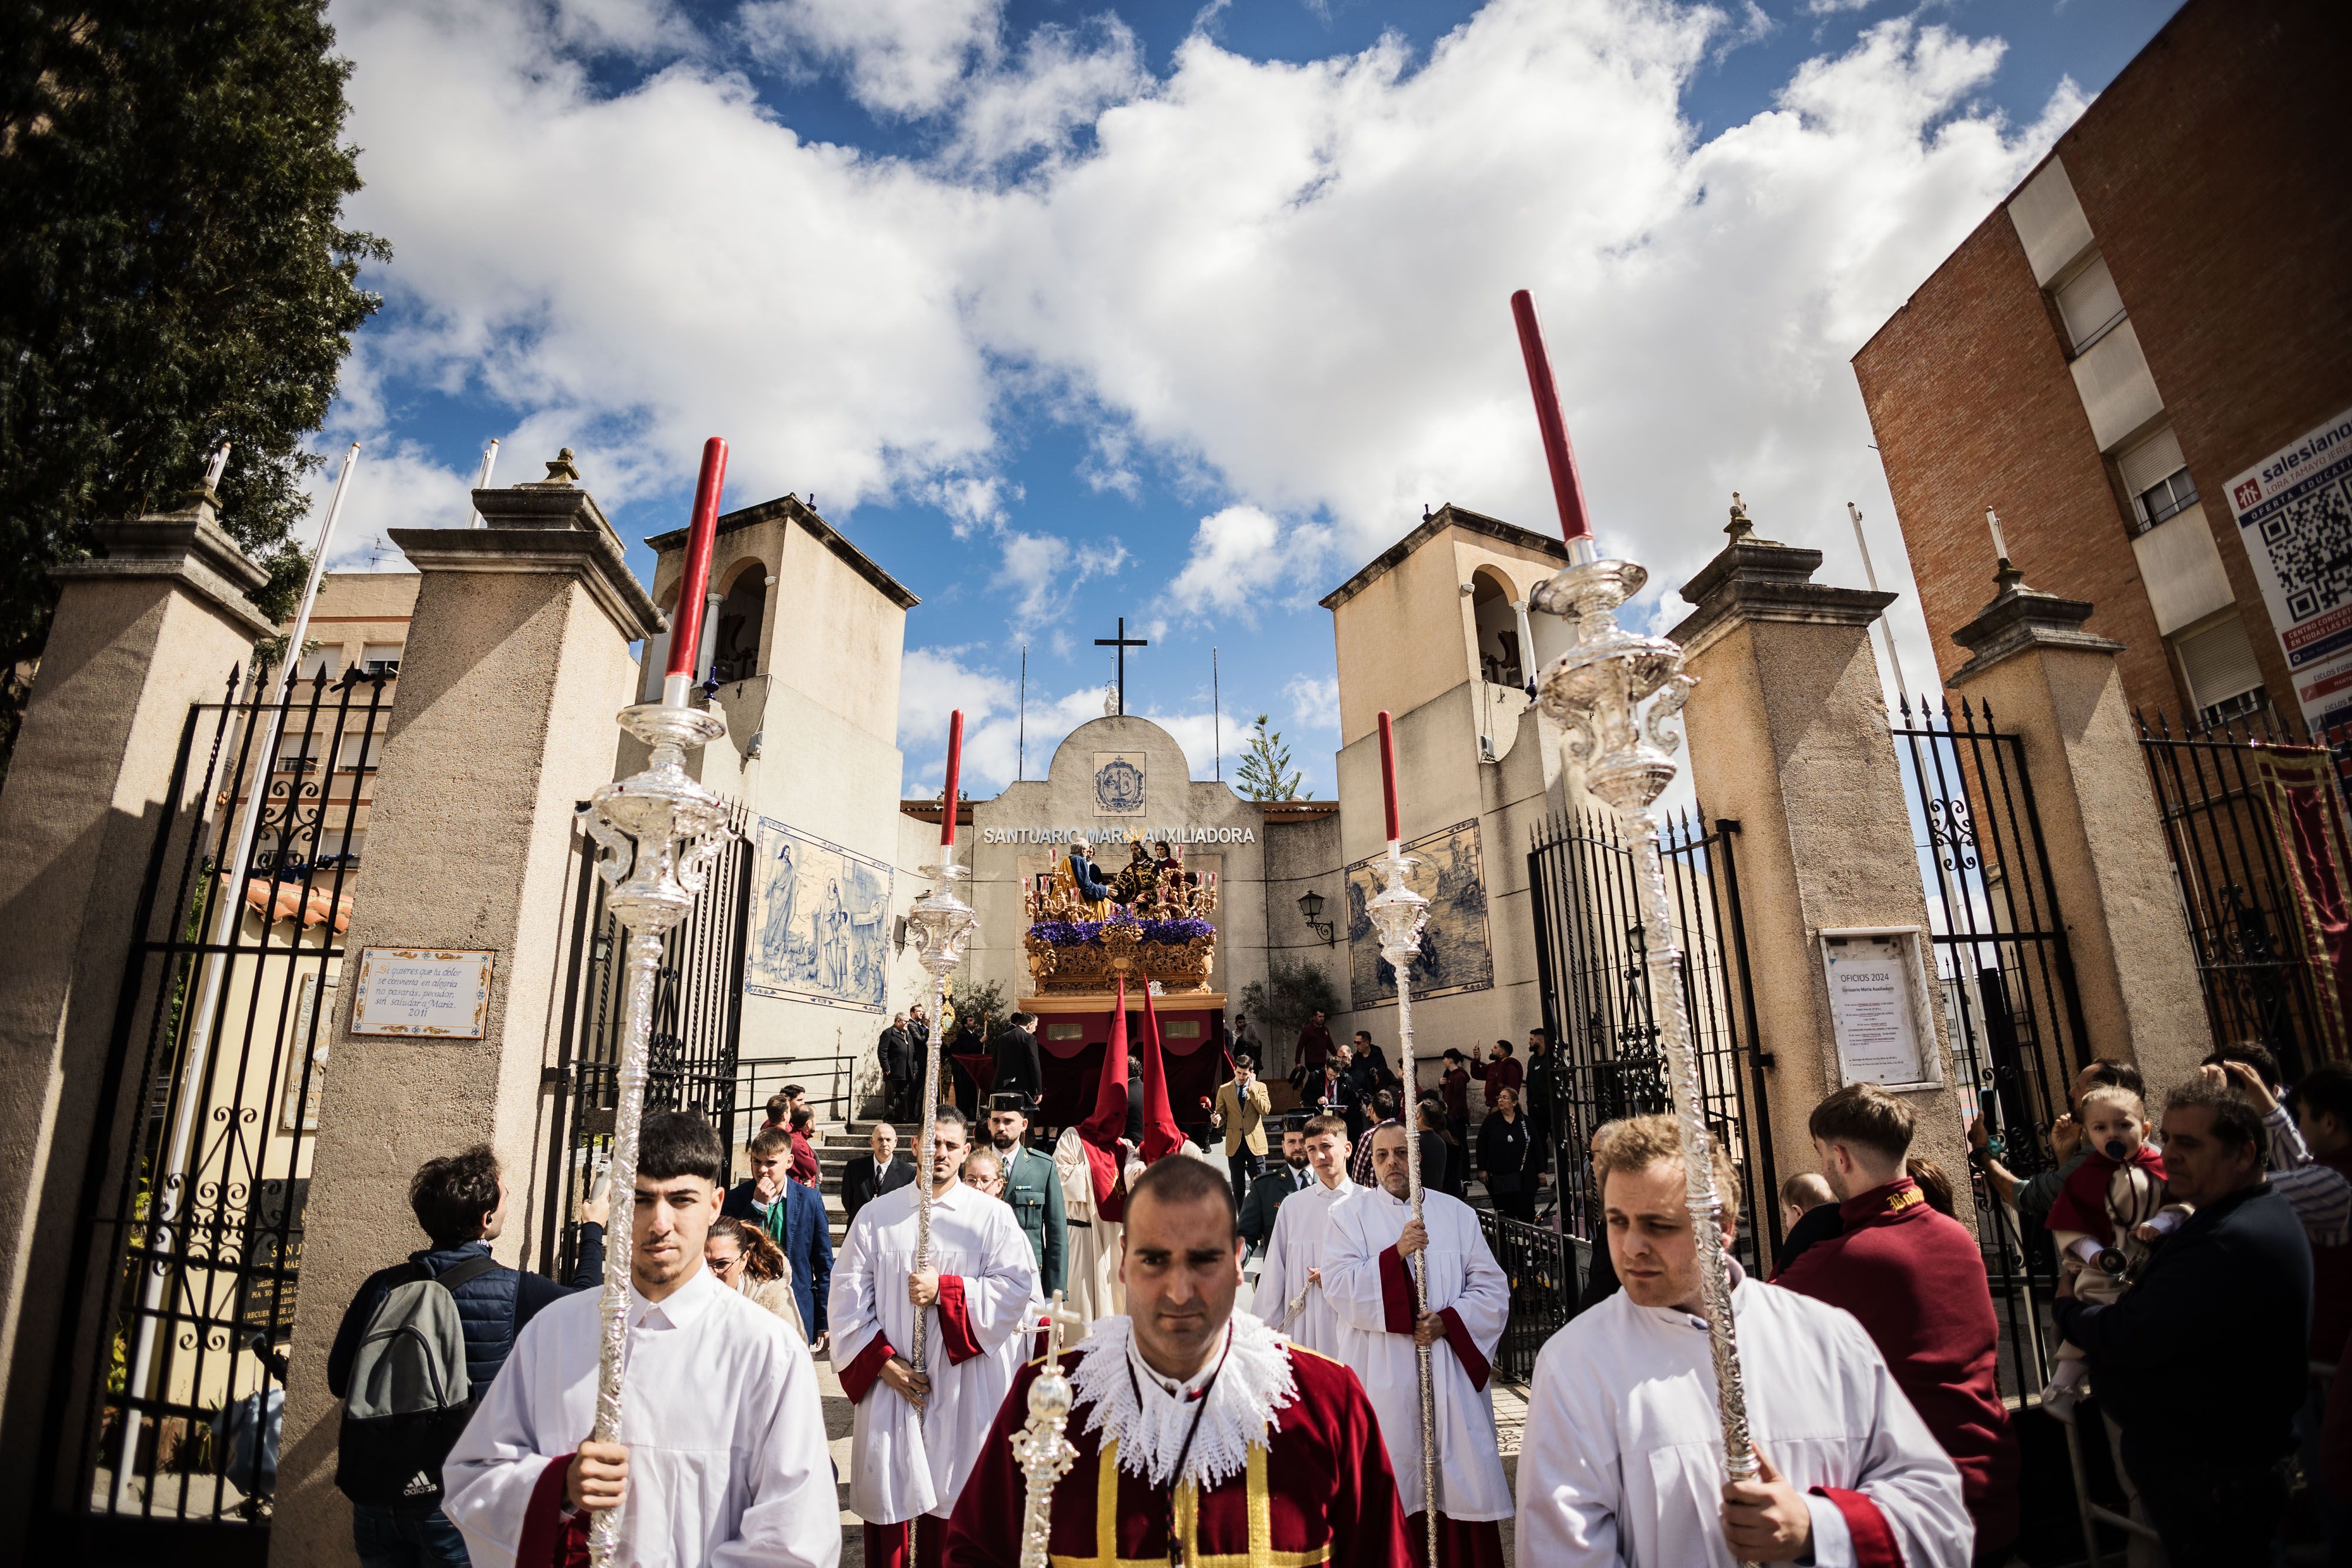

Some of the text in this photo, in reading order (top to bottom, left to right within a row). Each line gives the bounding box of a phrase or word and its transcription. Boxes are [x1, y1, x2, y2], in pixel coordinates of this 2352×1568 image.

[2263, 419, 2352, 483] salesiano
[2267, 479, 2289, 495] LORA
[2290, 456, 2326, 482] TAMAYO
[2251, 493, 2293, 519] OFERTA
[2288, 606, 2352, 638] CENTRO CONCERT
[2291, 615, 2352, 646] EN TODAS LAS ET
[2313, 669, 2336, 681] CICLOS
[2325, 699, 2348, 711] CICLOS
[983, 827, 1081, 845] SANTUARIO
[1144, 827, 1255, 844] AUXILIADORA
[375, 962, 462, 979] Si quieres que tu dolor
[1840, 973, 1889, 982] OFICIOS 2024
[387, 978, 419, 987] convierta
[432, 978, 458, 990] alegría
[390, 998, 420, 1008] saludar
[426, 998, 456, 1009] María.
[408, 1008, 427, 1018] 2011
[271, 1243, 294, 1258] SN
[403, 1483, 438, 1496] adidas
